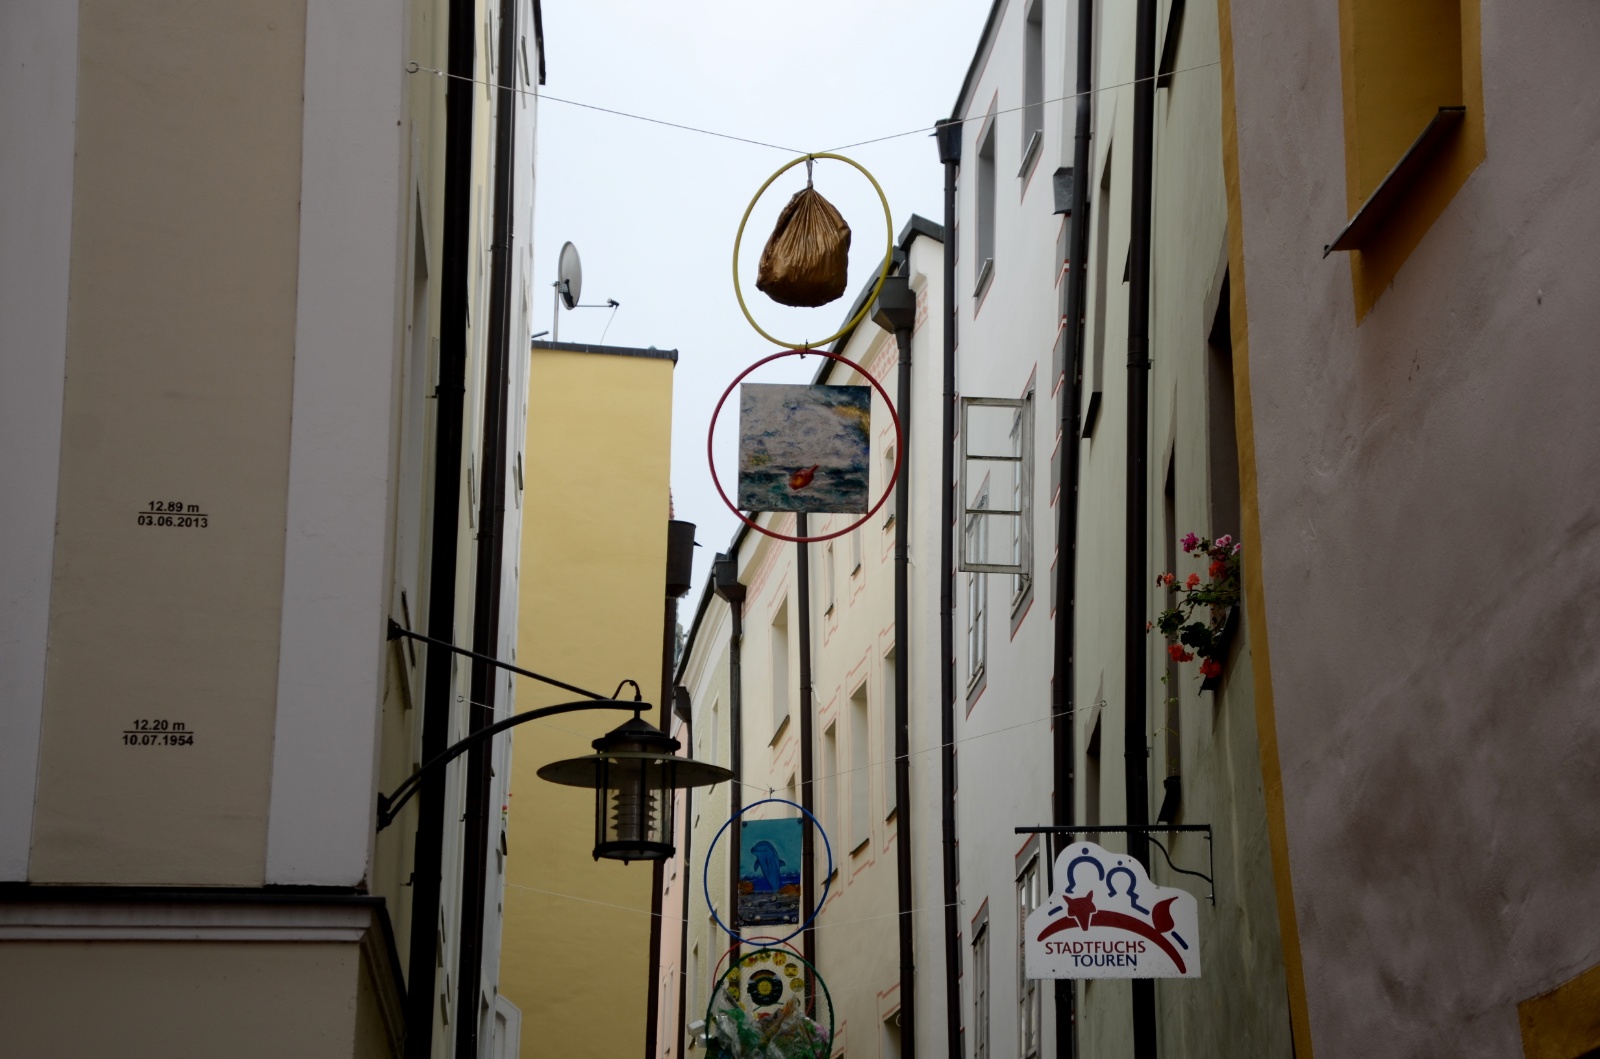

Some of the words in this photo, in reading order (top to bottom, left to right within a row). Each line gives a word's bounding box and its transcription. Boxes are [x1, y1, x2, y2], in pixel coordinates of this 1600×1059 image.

[148, 500, 183, 512] 12.89
[187, 504, 199, 512] m
[137, 515, 208, 528] 03.06.2013
[133, 719, 168, 731] 12.20
[172, 722, 185, 731] m
[122, 735, 194, 746] 10.07.1954
[1045, 941, 1146, 954] STADTFUCHS
[1071, 954, 1137, 966] TOUREN
